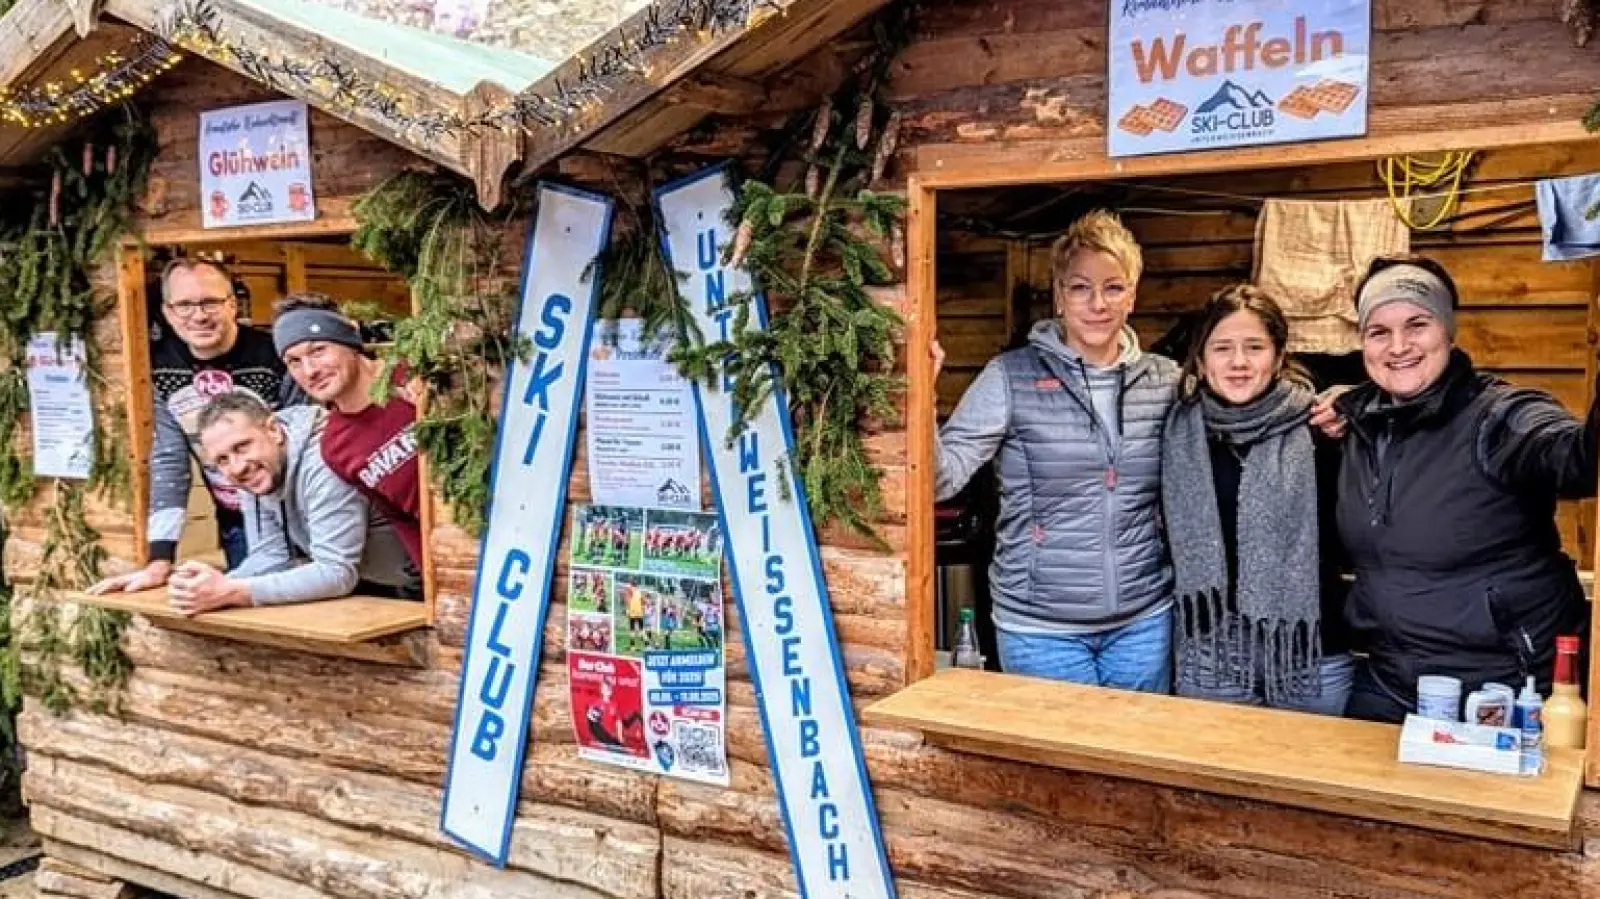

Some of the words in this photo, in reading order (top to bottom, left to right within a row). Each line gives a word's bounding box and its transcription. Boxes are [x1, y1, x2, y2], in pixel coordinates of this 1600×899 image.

[1130, 15, 1344, 84] Waffeln
[209, 144, 300, 177] Glühwein
[1191, 108, 1274, 134] SKI-CLUB
[523, 292, 572, 466] SKI
[697, 228, 850, 881] UNTEWEISSENBACH
[469, 548, 532, 761] CLUB
